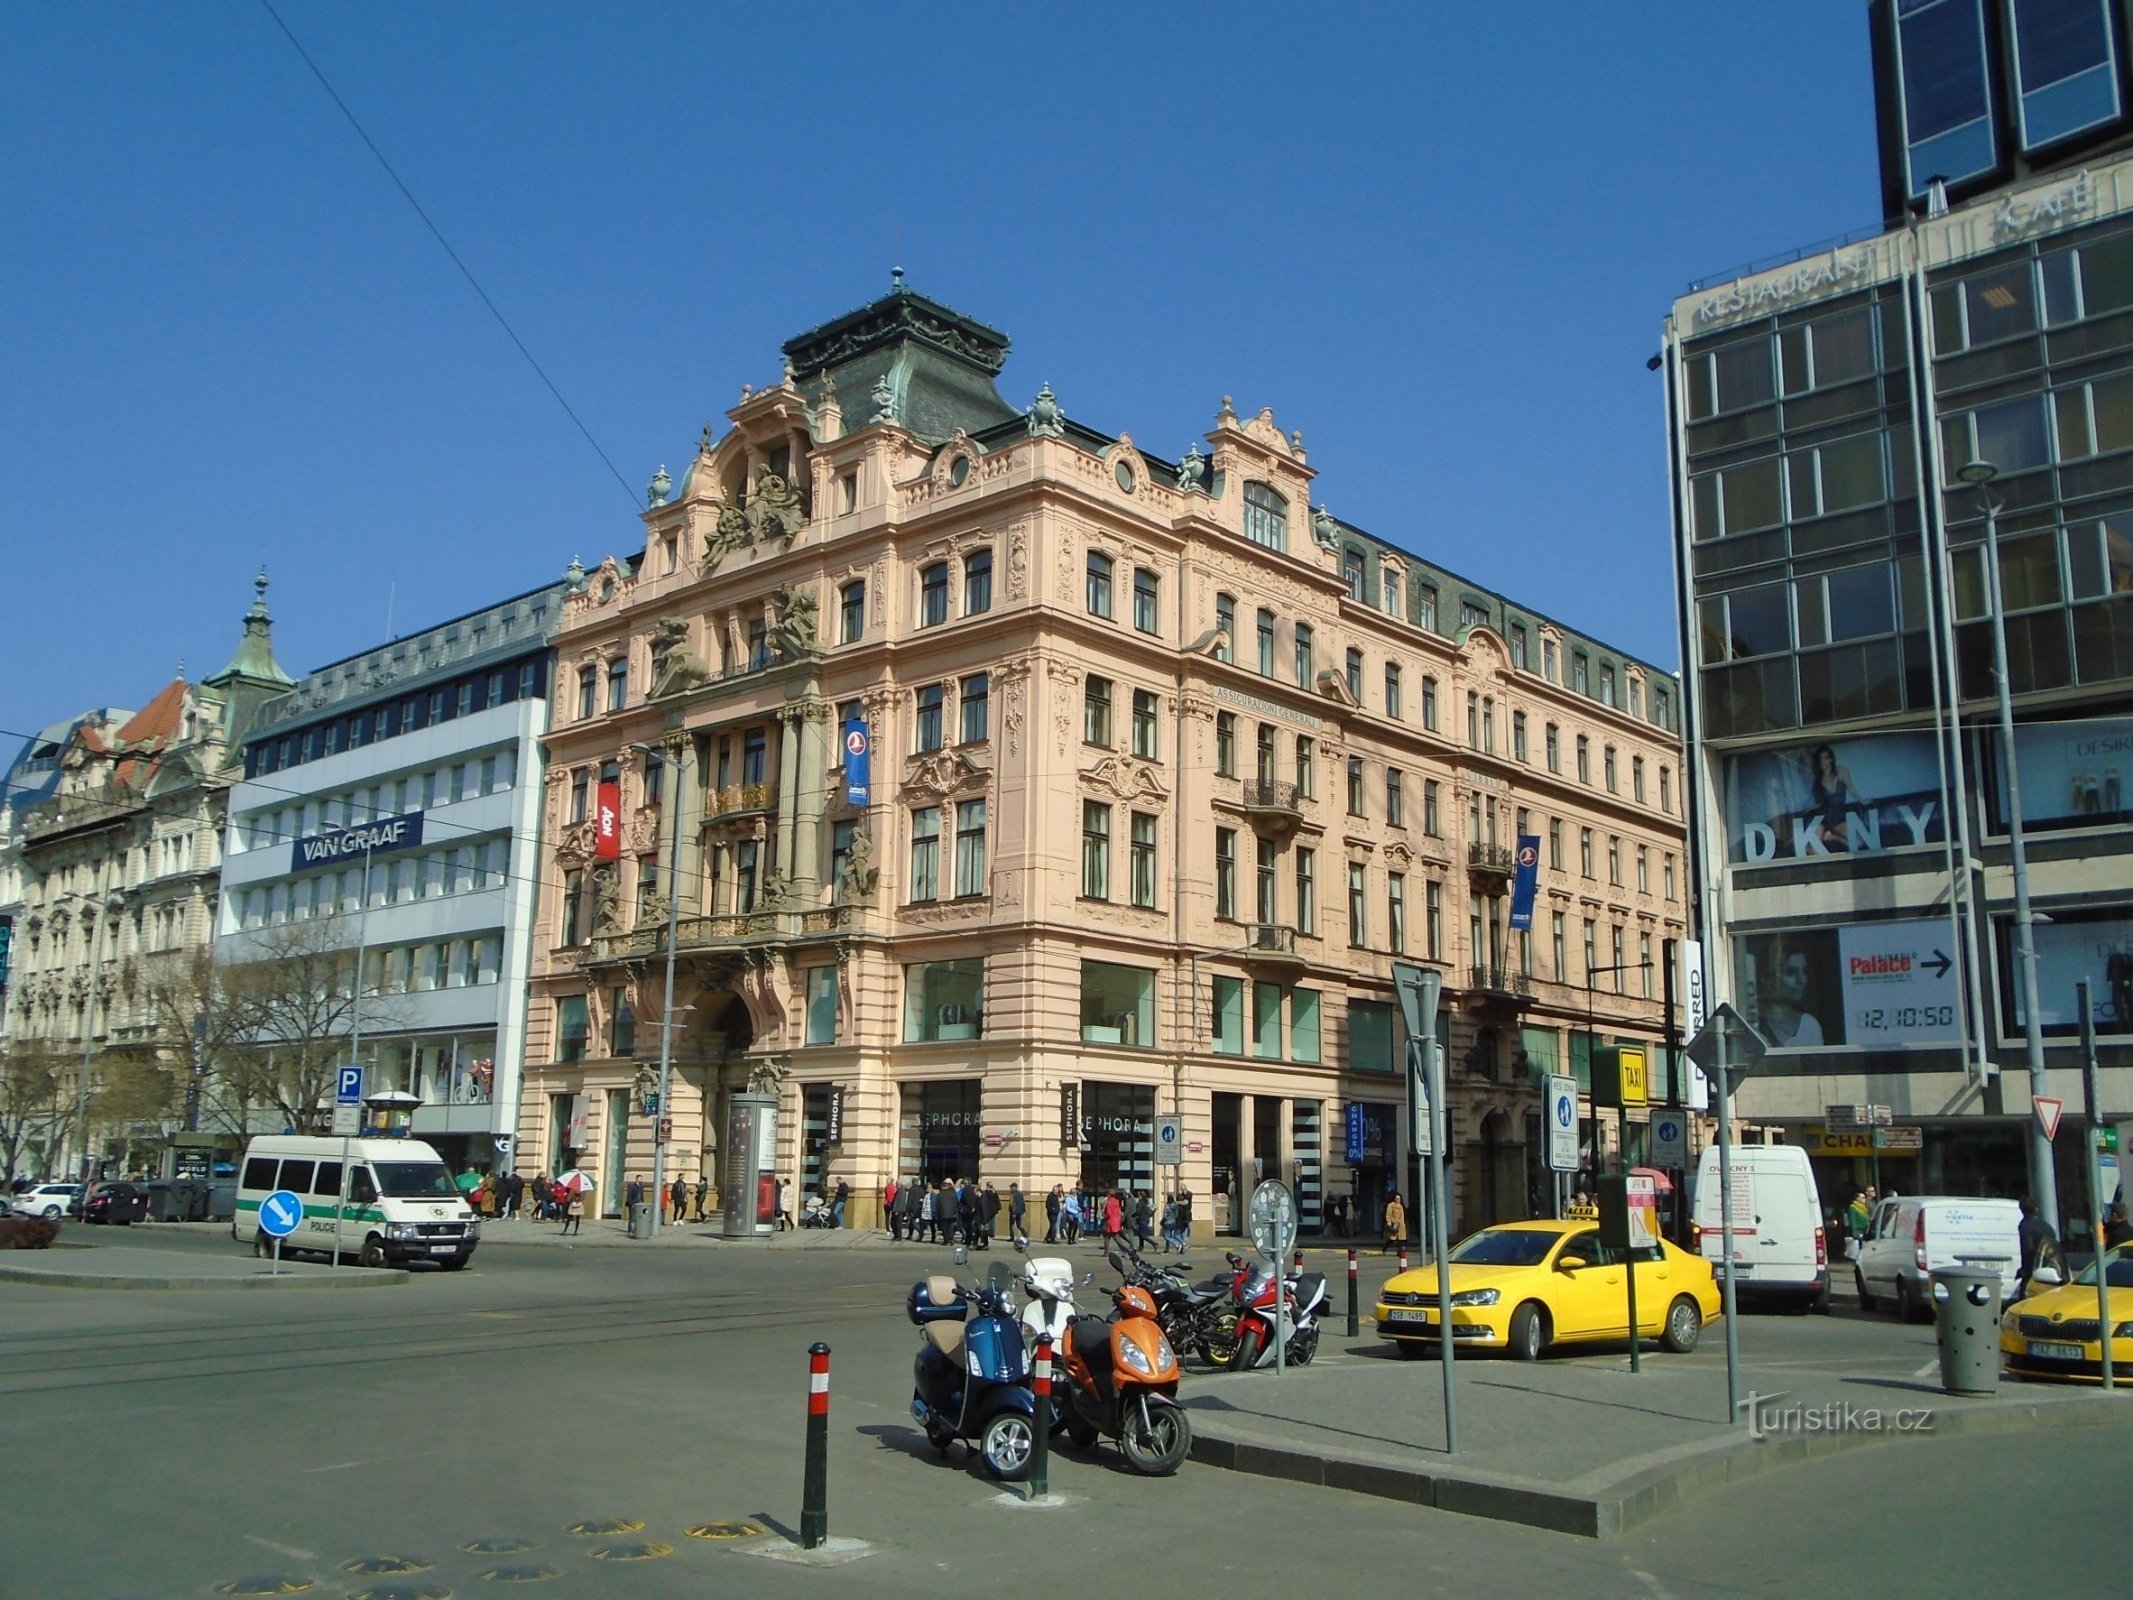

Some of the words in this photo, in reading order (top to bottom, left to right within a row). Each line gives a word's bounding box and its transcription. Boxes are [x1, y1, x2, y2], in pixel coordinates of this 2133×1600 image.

[1701, 247, 1876, 322] RESTAURANT
[1218, 687, 1279, 714] ASSICURAZIONI
[1280, 709, 1318, 727] GENERALI
[2077, 736, 2133, 757] DESIR
[303, 837, 339, 861] VAN
[341, 821, 408, 853] GRAAF
[1744, 802, 1936, 863] DKNY
[1850, 955, 1911, 975] Palace
[341, 1071, 358, 1093] P
[1624, 1066, 1642, 1088] TAXI
[830, 1092, 839, 1140] SEPHORA
[1824, 1133, 1872, 1148] CHA
[311, 1221, 336, 1232] POLICIE
